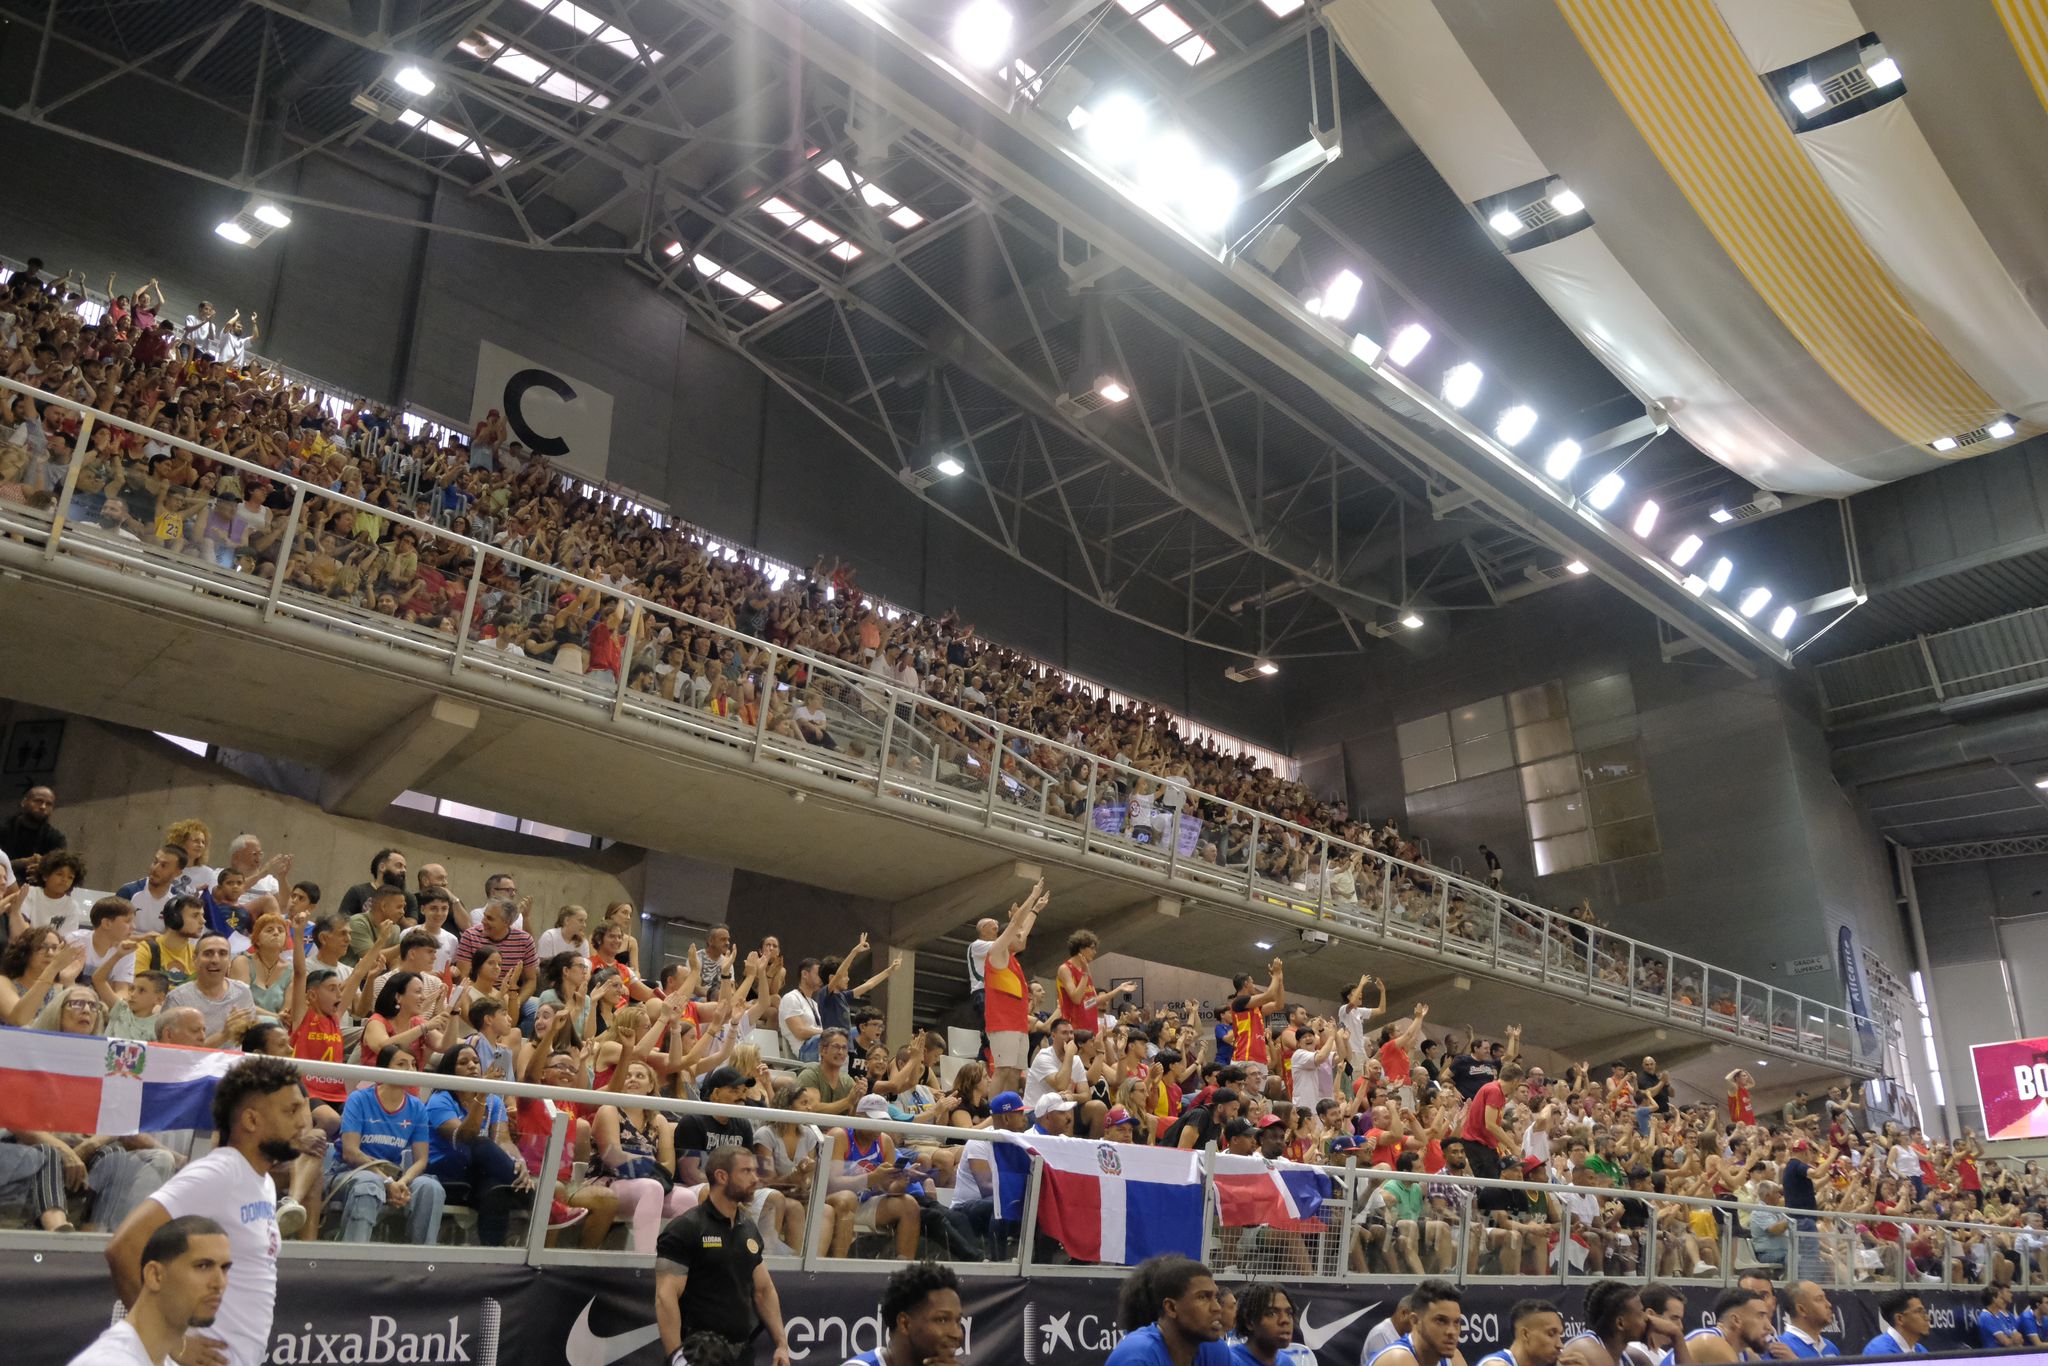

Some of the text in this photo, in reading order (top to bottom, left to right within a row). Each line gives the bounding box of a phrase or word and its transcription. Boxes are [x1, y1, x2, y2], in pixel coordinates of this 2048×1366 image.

[504, 369, 577, 456] C
[1202, 1000, 1209, 1009] C
[263, 1316, 470, 1364] aixaBank
